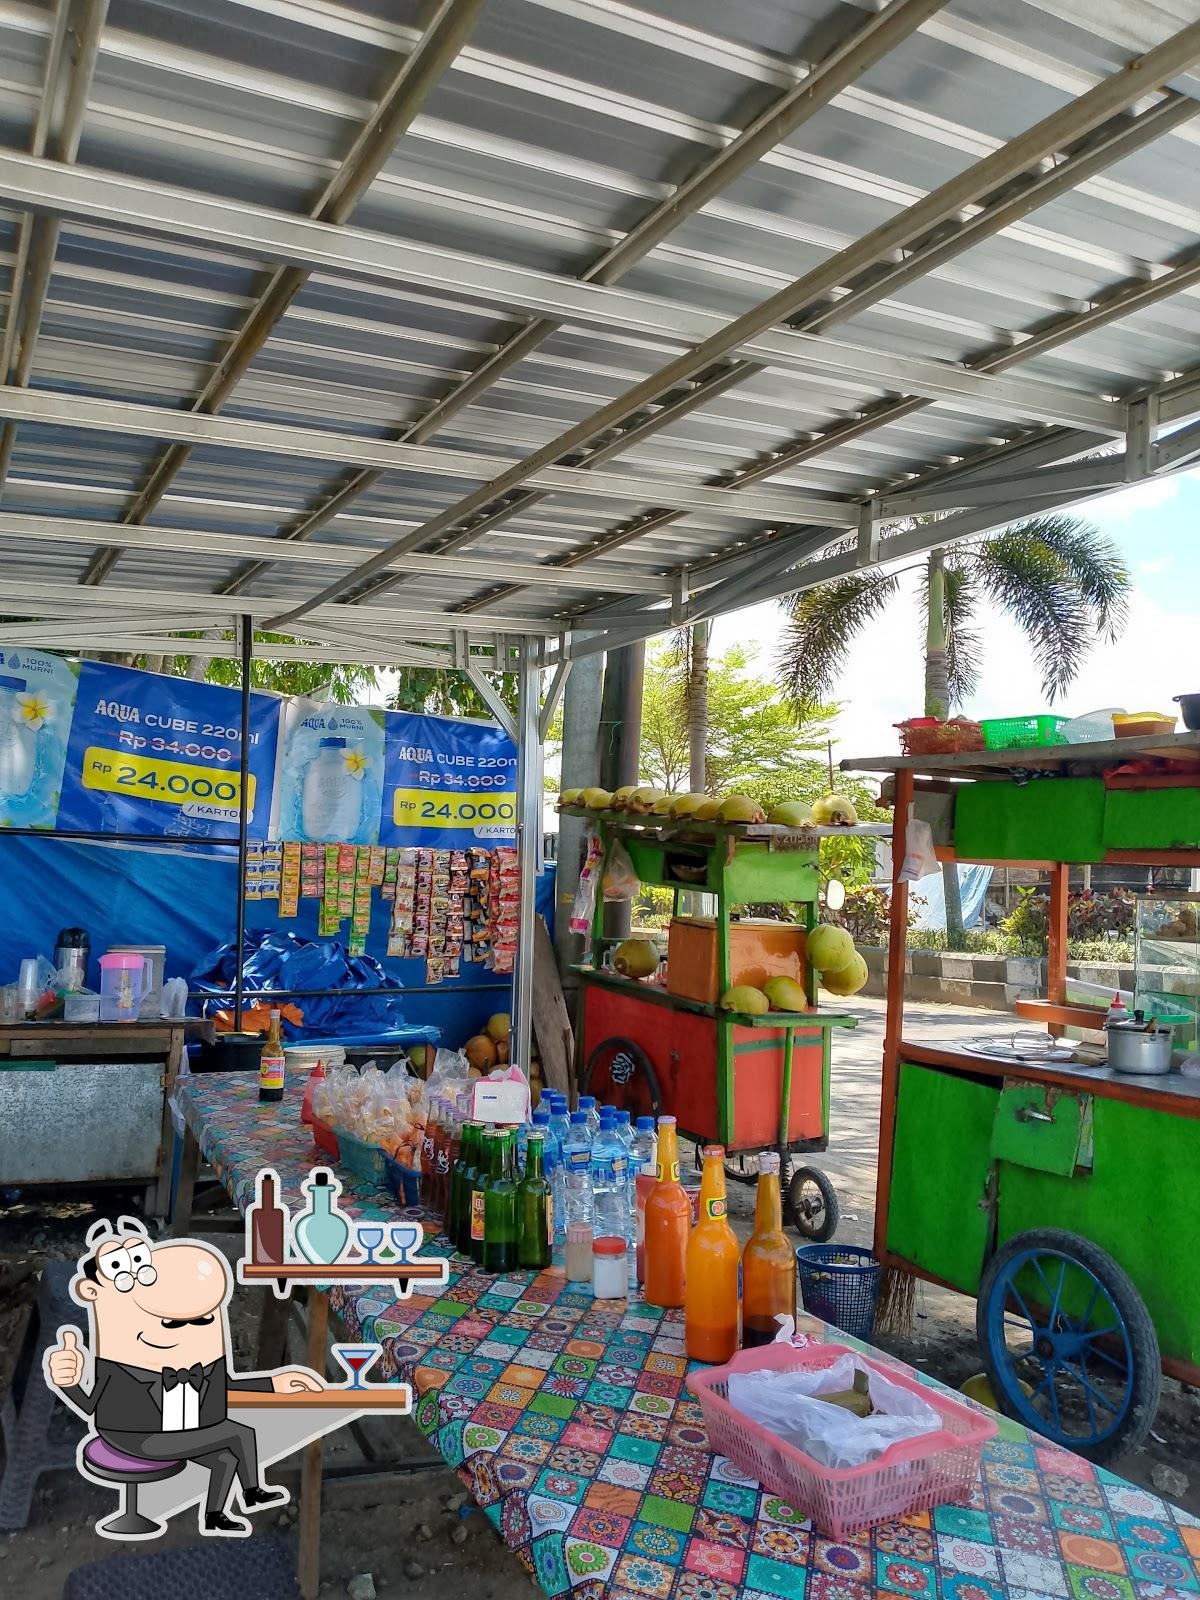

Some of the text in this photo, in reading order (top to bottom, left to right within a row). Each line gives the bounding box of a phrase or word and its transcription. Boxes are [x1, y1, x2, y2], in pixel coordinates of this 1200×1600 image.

[22, 663, 53, 675] MURNI
[25, 657, 52, 668] 100%
[94, 699, 141, 723] AQUA
[144, 714, 199, 734] CUBE
[301, 717, 325, 730] AQUA
[339, 723, 364, 731] MURNI
[118, 730, 232, 762] Rp 34.000
[398, 746, 518, 768] AQUA CUBE 220m
[92, 761, 112, 774] Rp
[418, 770, 507, 787] Rp 34.000
[197, 806, 242, 818] KARTO
[400, 801, 514, 820] Rp 24.000
